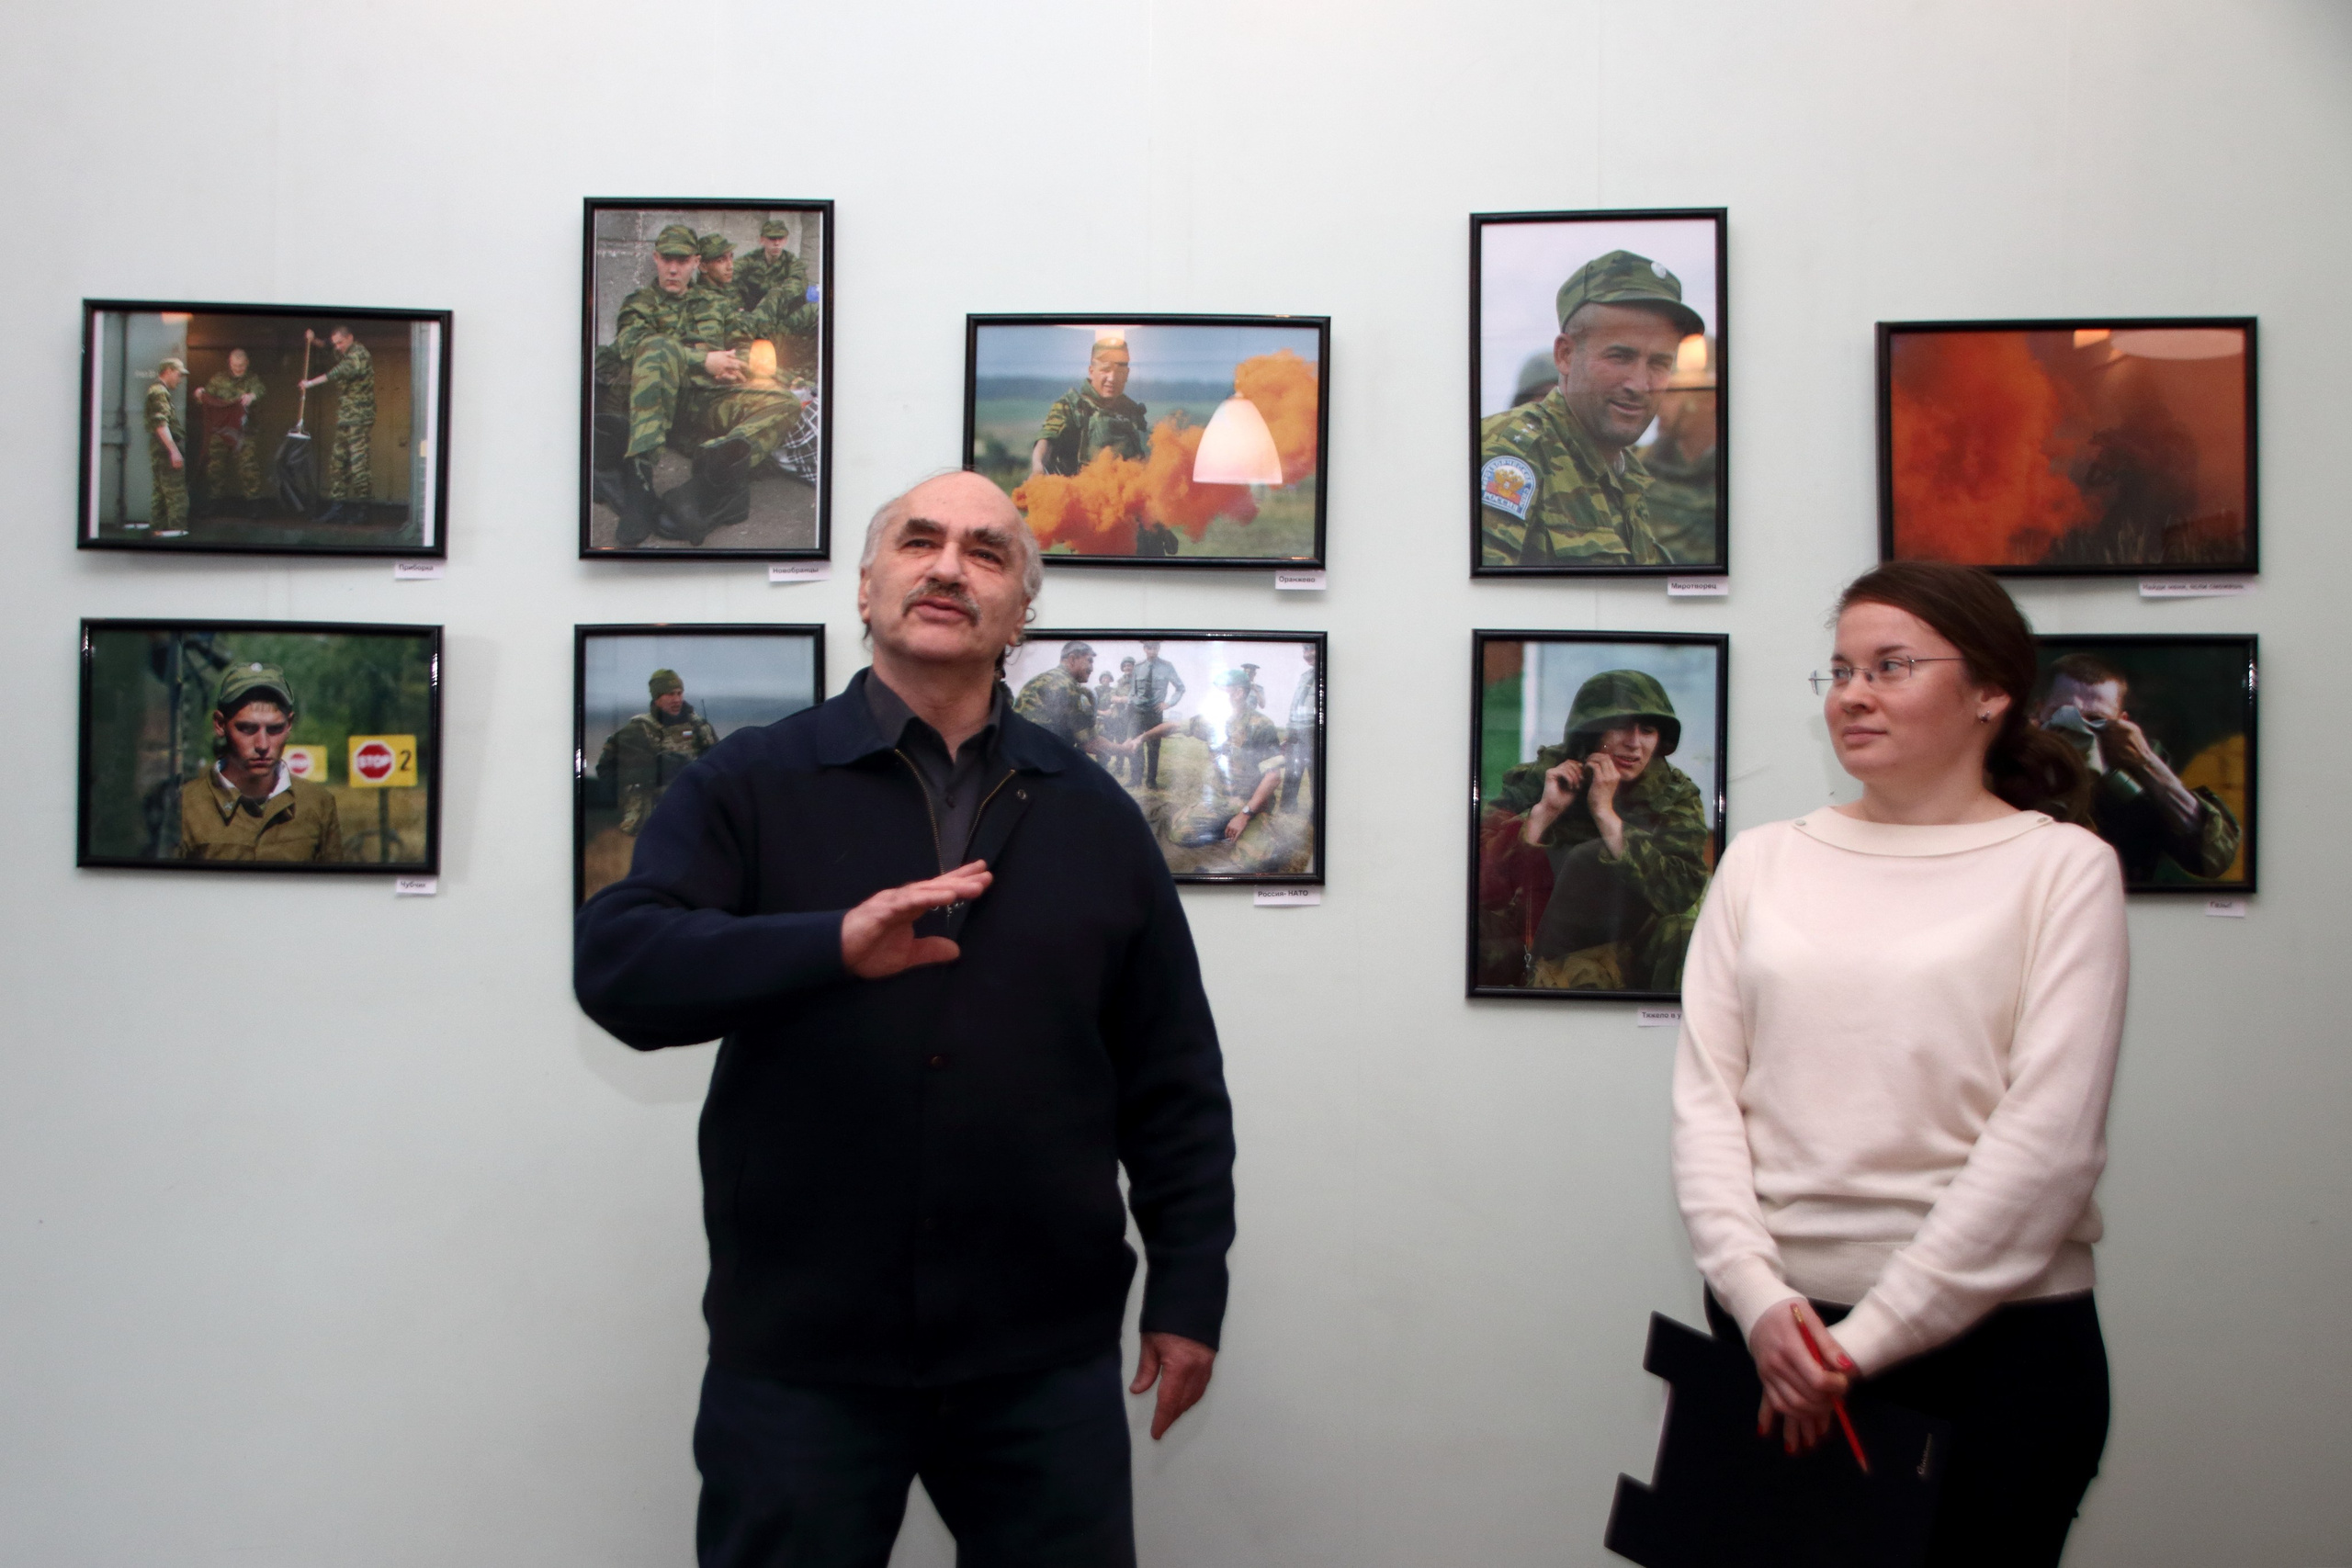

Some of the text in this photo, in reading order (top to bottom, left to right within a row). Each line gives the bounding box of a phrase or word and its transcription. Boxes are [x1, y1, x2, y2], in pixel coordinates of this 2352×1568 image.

[398, 563, 434, 571] Приборка
[1278, 575, 1316, 583] Оранжево
[357, 749, 412, 772] STOP 2
